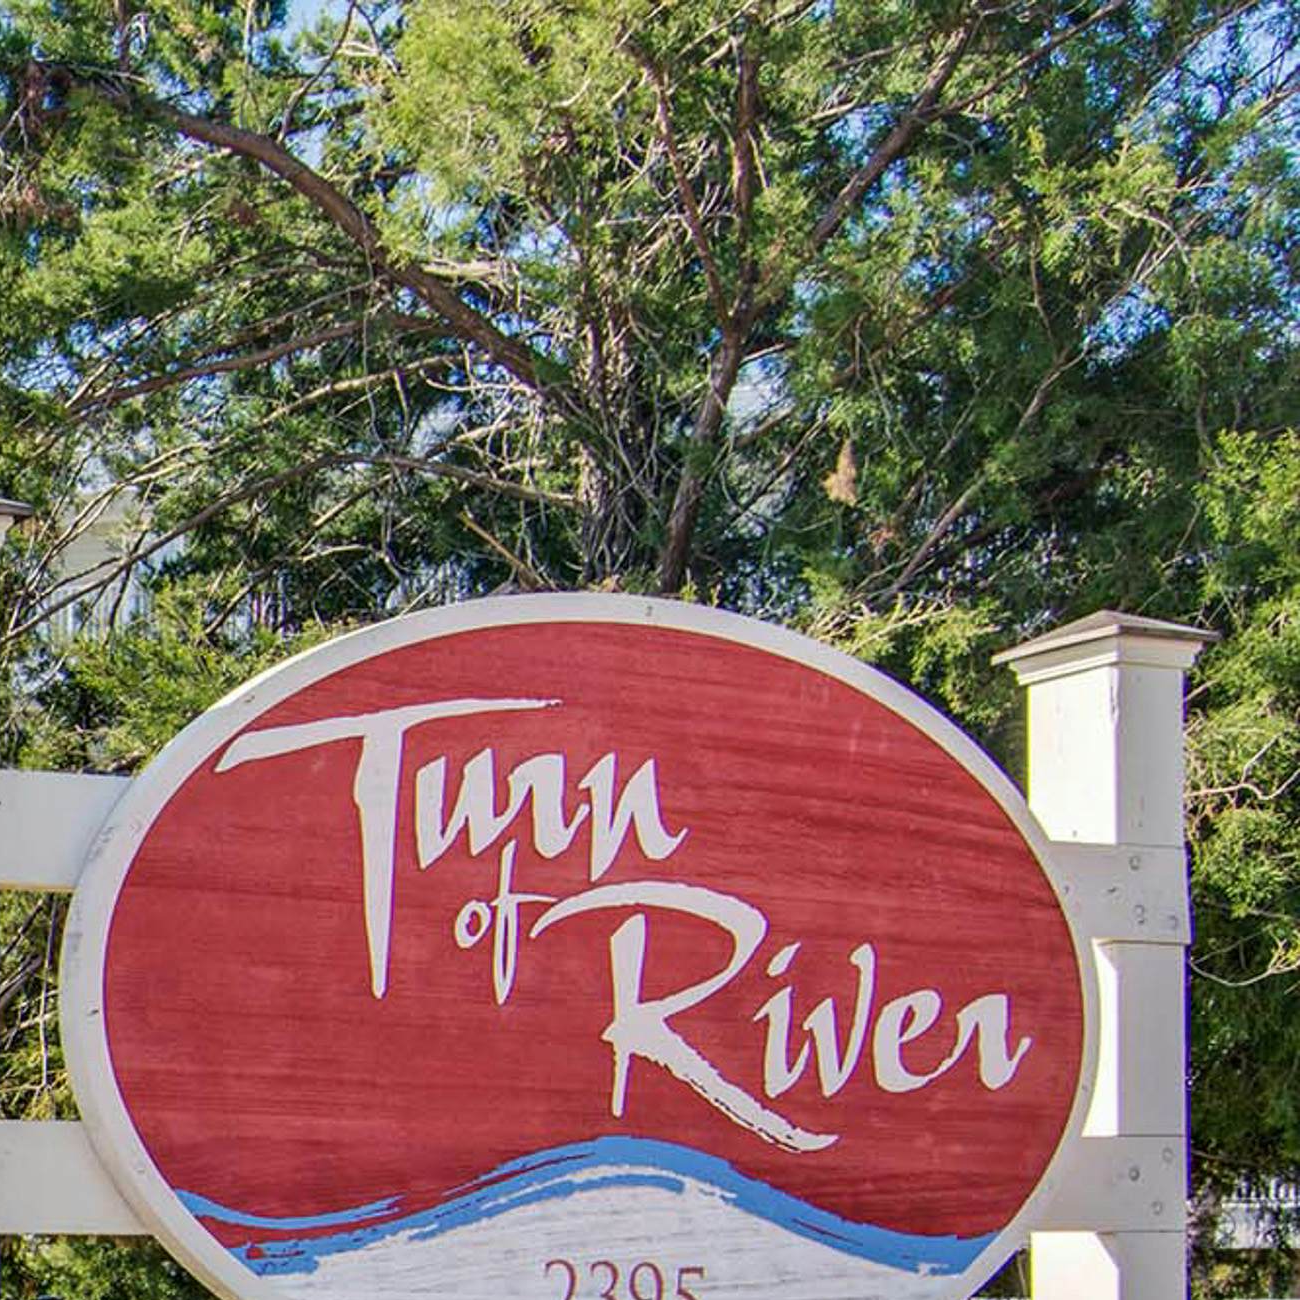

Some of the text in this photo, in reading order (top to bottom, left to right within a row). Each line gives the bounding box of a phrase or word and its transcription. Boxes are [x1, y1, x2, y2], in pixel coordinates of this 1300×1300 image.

[214, 698, 688, 999] Turn
[455, 838, 556, 1005] of
[530, 881, 1032, 1153] River
